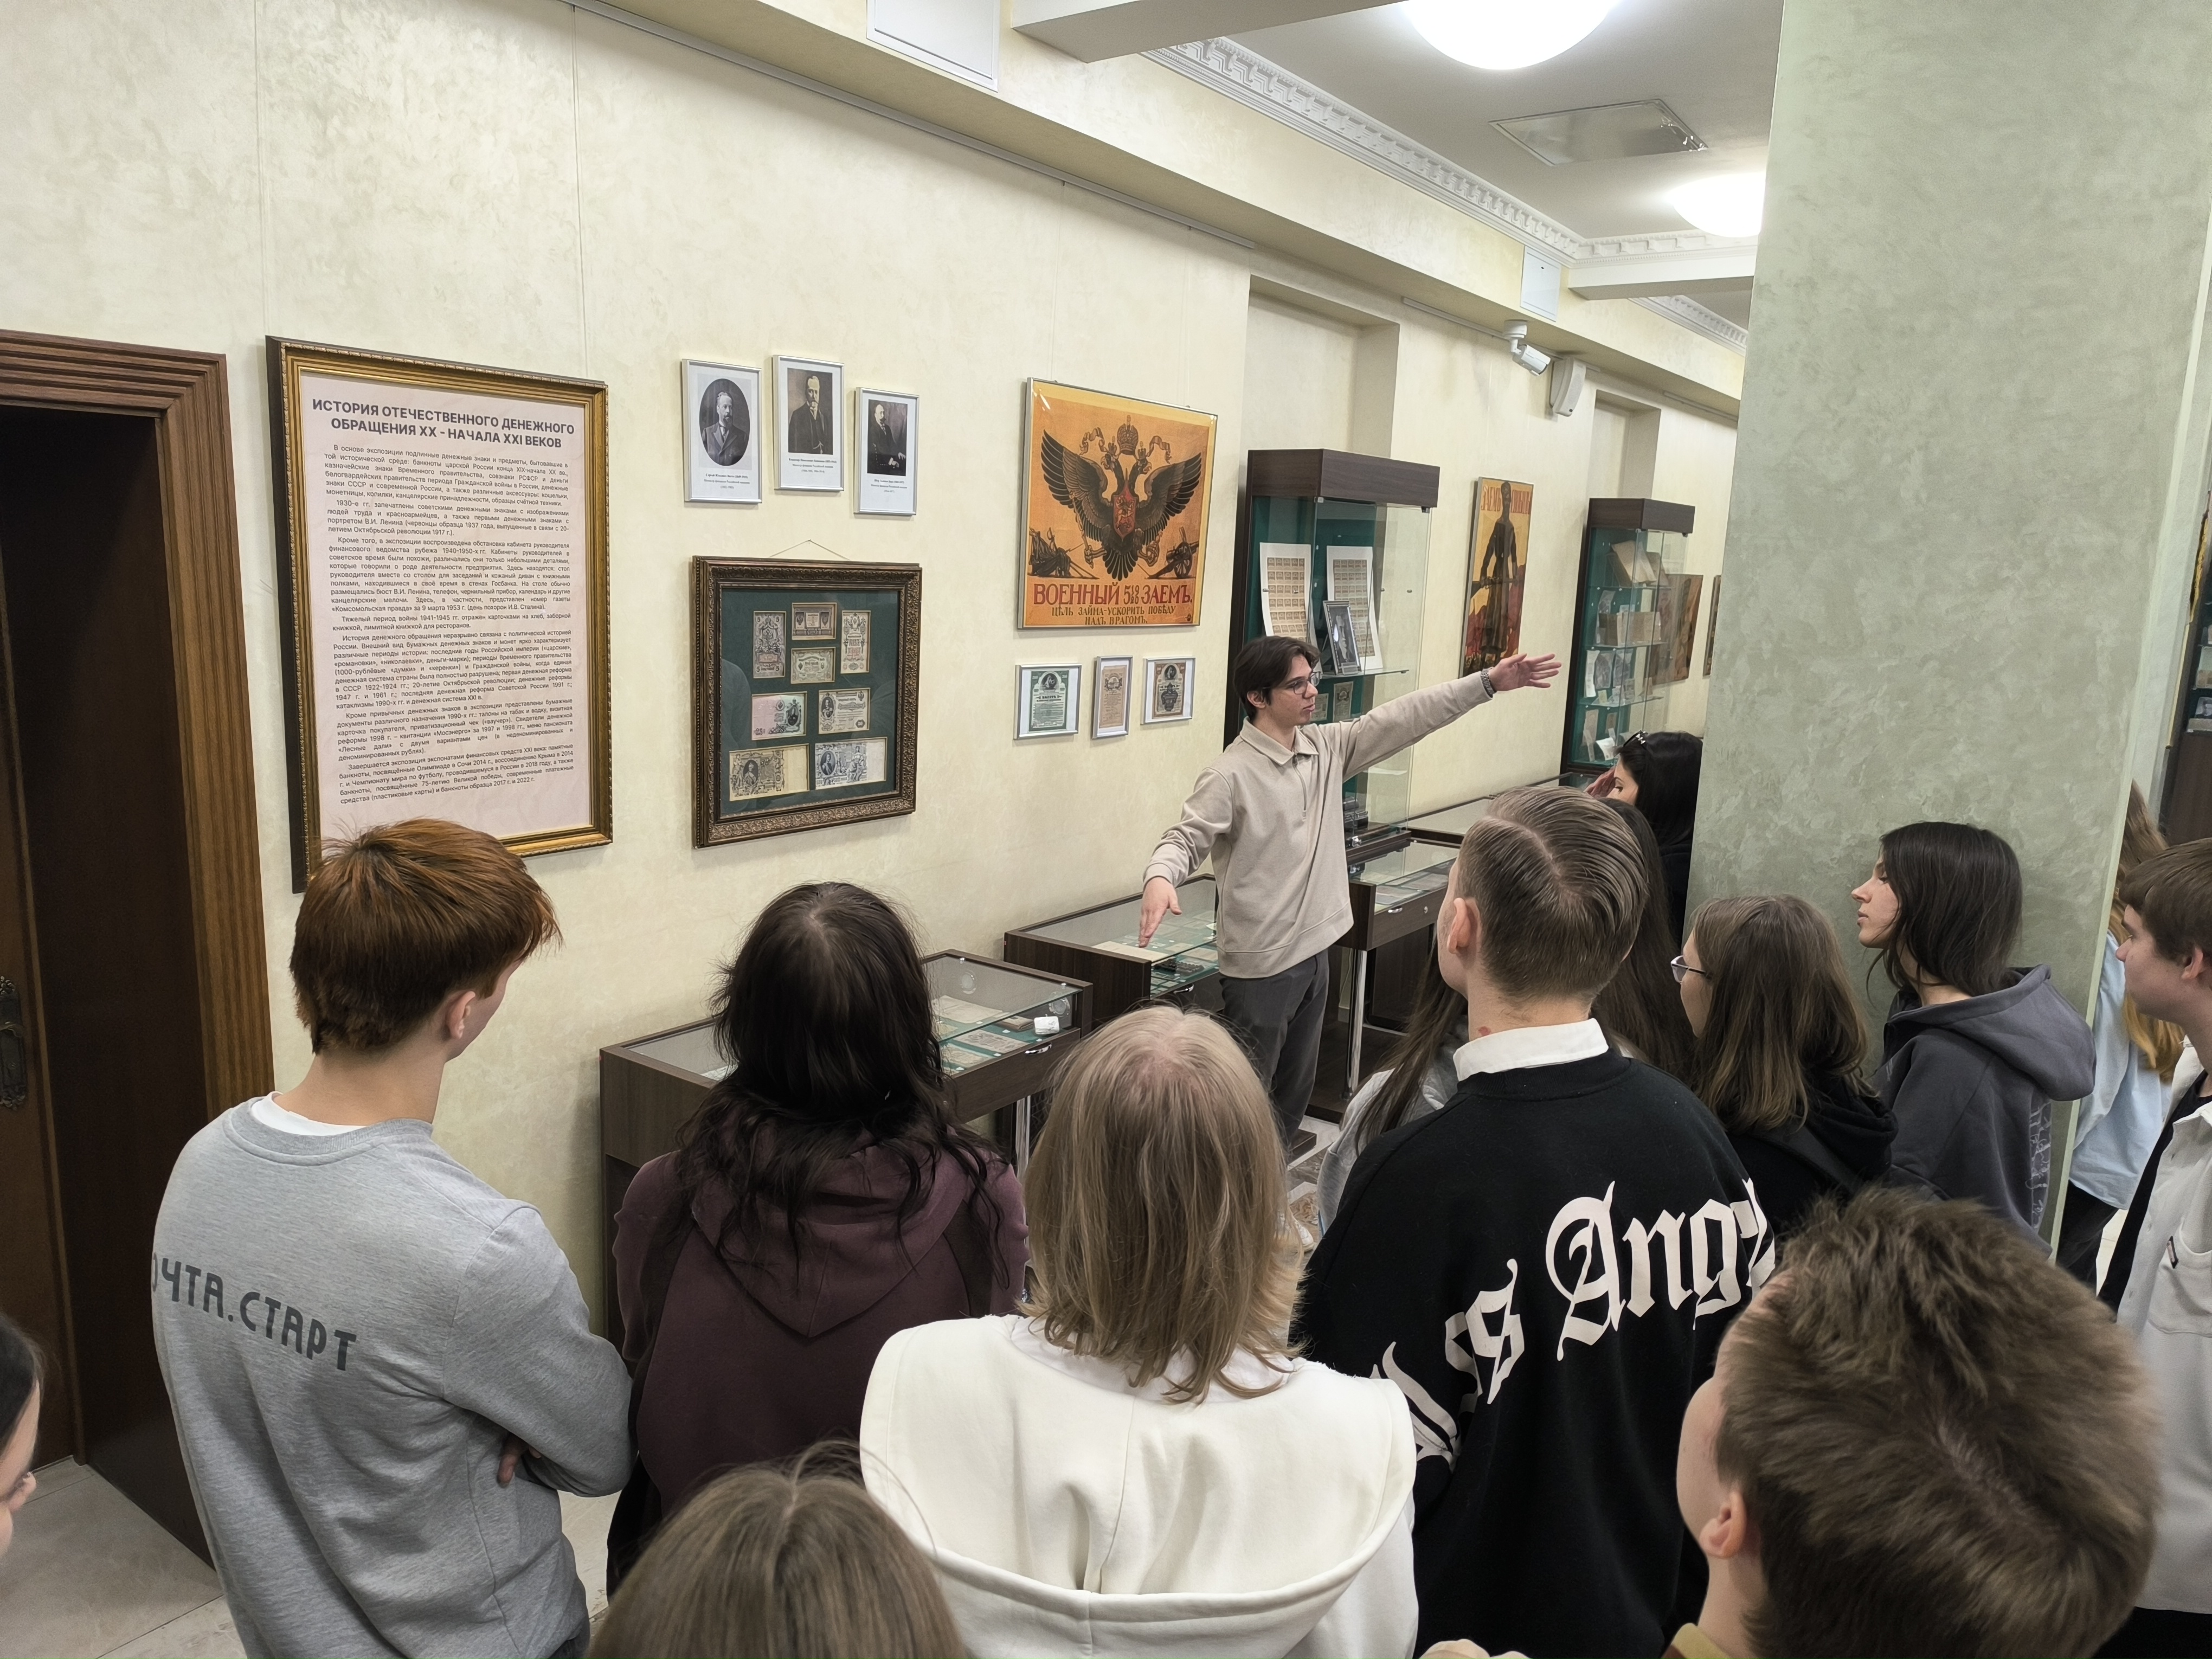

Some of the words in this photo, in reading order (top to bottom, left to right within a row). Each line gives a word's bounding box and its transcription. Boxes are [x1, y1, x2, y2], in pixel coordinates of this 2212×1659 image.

[312, 398, 378, 416] ИСТОРИЯ
[382, 406, 499, 427] ОТЕЧЕСТВЕННОГО
[501, 417, 574, 434] ДЕНЕЖНОГО
[331, 417, 416, 435] ОБРАЩЕНИЯ
[419, 425, 437, 437] XX
[448, 428, 501, 443] НАЧАЛА
[503, 433, 523, 445] XXI
[525, 435, 562, 448] ВЕКОВ
[366, 448, 403, 456] экспозиции
[530, 459, 563, 467] бытовавшие
[325, 471, 382, 480] белогвардейских
[454, 478, 492, 486] Гражданской
[398, 466, 435, 475] Временного
[439, 470, 484, 479] правительства,
[353, 526, 395, 535] Октябрьской
[1033, 582, 1119, 605] ВОЕННЫЙ
[1141, 584, 1192, 605] ЗАЕМЪ.
[1085, 616, 1106, 625] НАДЪ
[426, 655, 471, 664] деньги-марки);
[335, 667, 386, 676] (1000-рублёвые
[428, 664, 461, 672] «керенки»)
[370, 710, 404, 718] привычных
[340, 796, 370, 805] средства
[371, 791, 413, 801] (пластиковые
[414, 787, 434, 795] карты)
